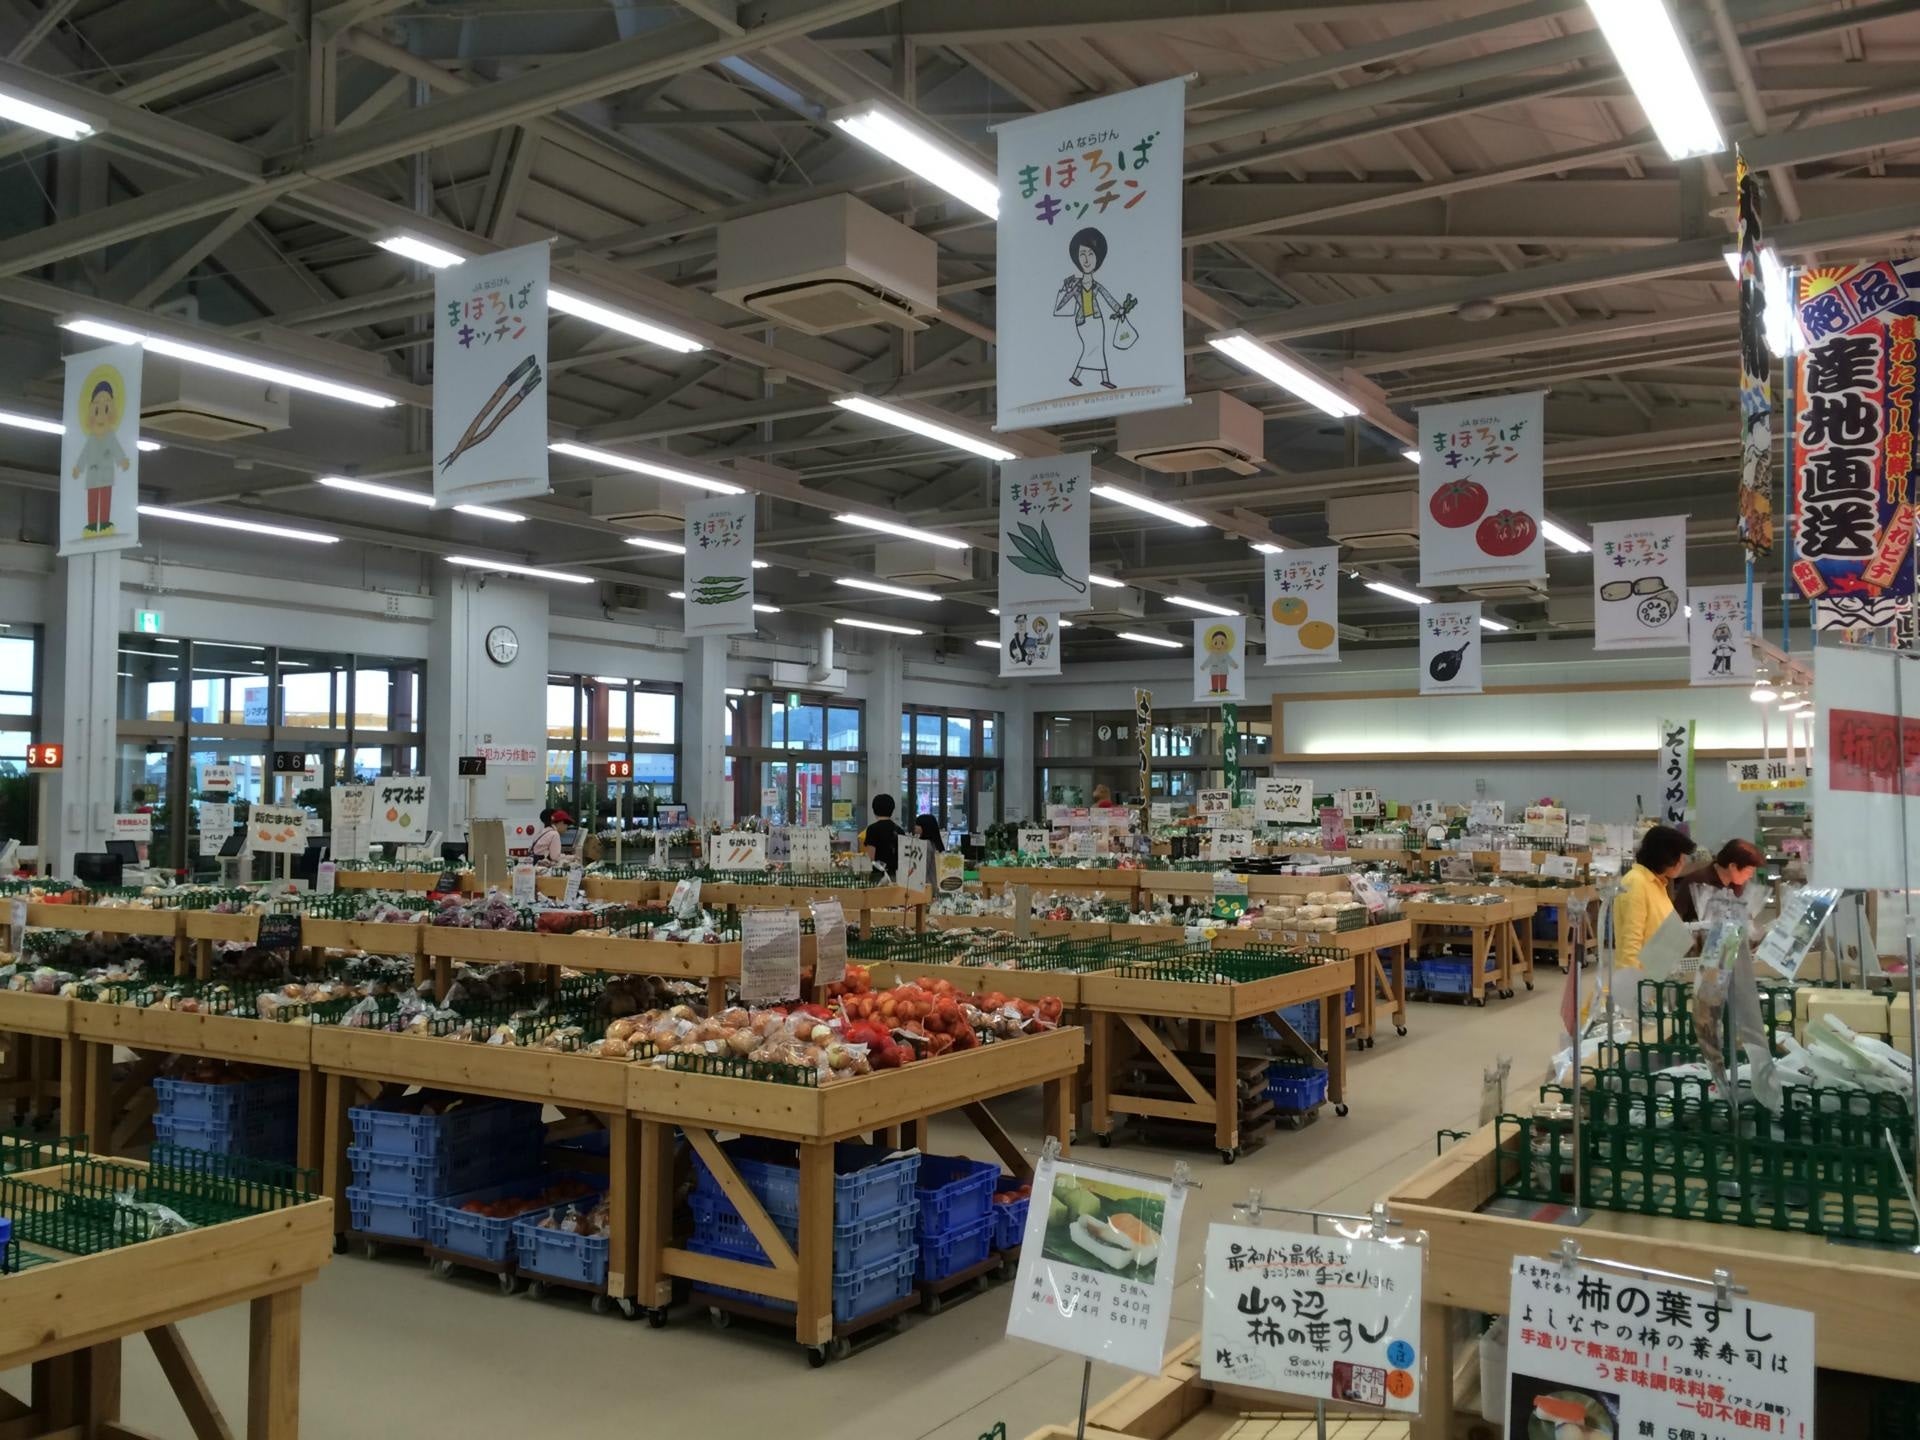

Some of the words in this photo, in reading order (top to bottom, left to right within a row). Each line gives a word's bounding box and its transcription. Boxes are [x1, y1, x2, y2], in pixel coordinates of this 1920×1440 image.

[1058, 141, 1074, 152] JA
[1077, 128, 1120, 148] ならけん
[1017, 131, 1161, 199] まほろば
[1034, 179, 1147, 226] キッチン
[448, 280, 535, 327] まほろば
[1802, 270, 1901, 341] 絶品
[458, 315, 527, 349] キッチン
[1433, 420, 1528, 453] まほろば
[1801, 334, 1883, 559] 産地直送
[1444, 446, 1520, 468] キッチン
[1010, 474, 1080, 501] まほろば
[1019, 497, 1073, 515] キッチン
[693, 515, 745, 536] まほろば
[700, 533, 741, 549] キッチン
[1604, 536, 1673, 556] まほろば
[1613, 552, 1668, 567] キッチン
[1273, 564, 1328, 581] まほろば
[1281, 578, 1325, 592] キッチン
[1427, 615, 1472, 628] まほろば
[1432, 626, 1470, 638] キッチン
[29, 748, 36, 764] 5
[44, 748, 57, 764] 5
[277, 755, 285, 768] 6
[292, 755, 301, 768] 6
[474, 760, 483, 771] 7
[610, 763, 616, 775] 8
[621, 763, 629, 775] 8
[1665, 726, 1686, 823] そうめん
[381, 786, 425, 804] タマネギ
[1267, 784, 1302, 795] ニンニク
[1026, 833, 1043, 842] タマゴ
[1225, 1243, 1349, 1272] 最初から最後まで
[1112, 1296, 1150, 1314] 540円
[1237, 1286, 1329, 1320] 山の辺
[1577, 1275, 1773, 1343] 柿の葉すし
[1110, 1311, 1148, 1330] 561円
[1246, 1315, 1390, 1354] 柿の葉すし
[1522, 1304, 1788, 1374] よしなやの柿の葉寿司は
[1596, 1365, 1726, 1403] うま味調味料等
